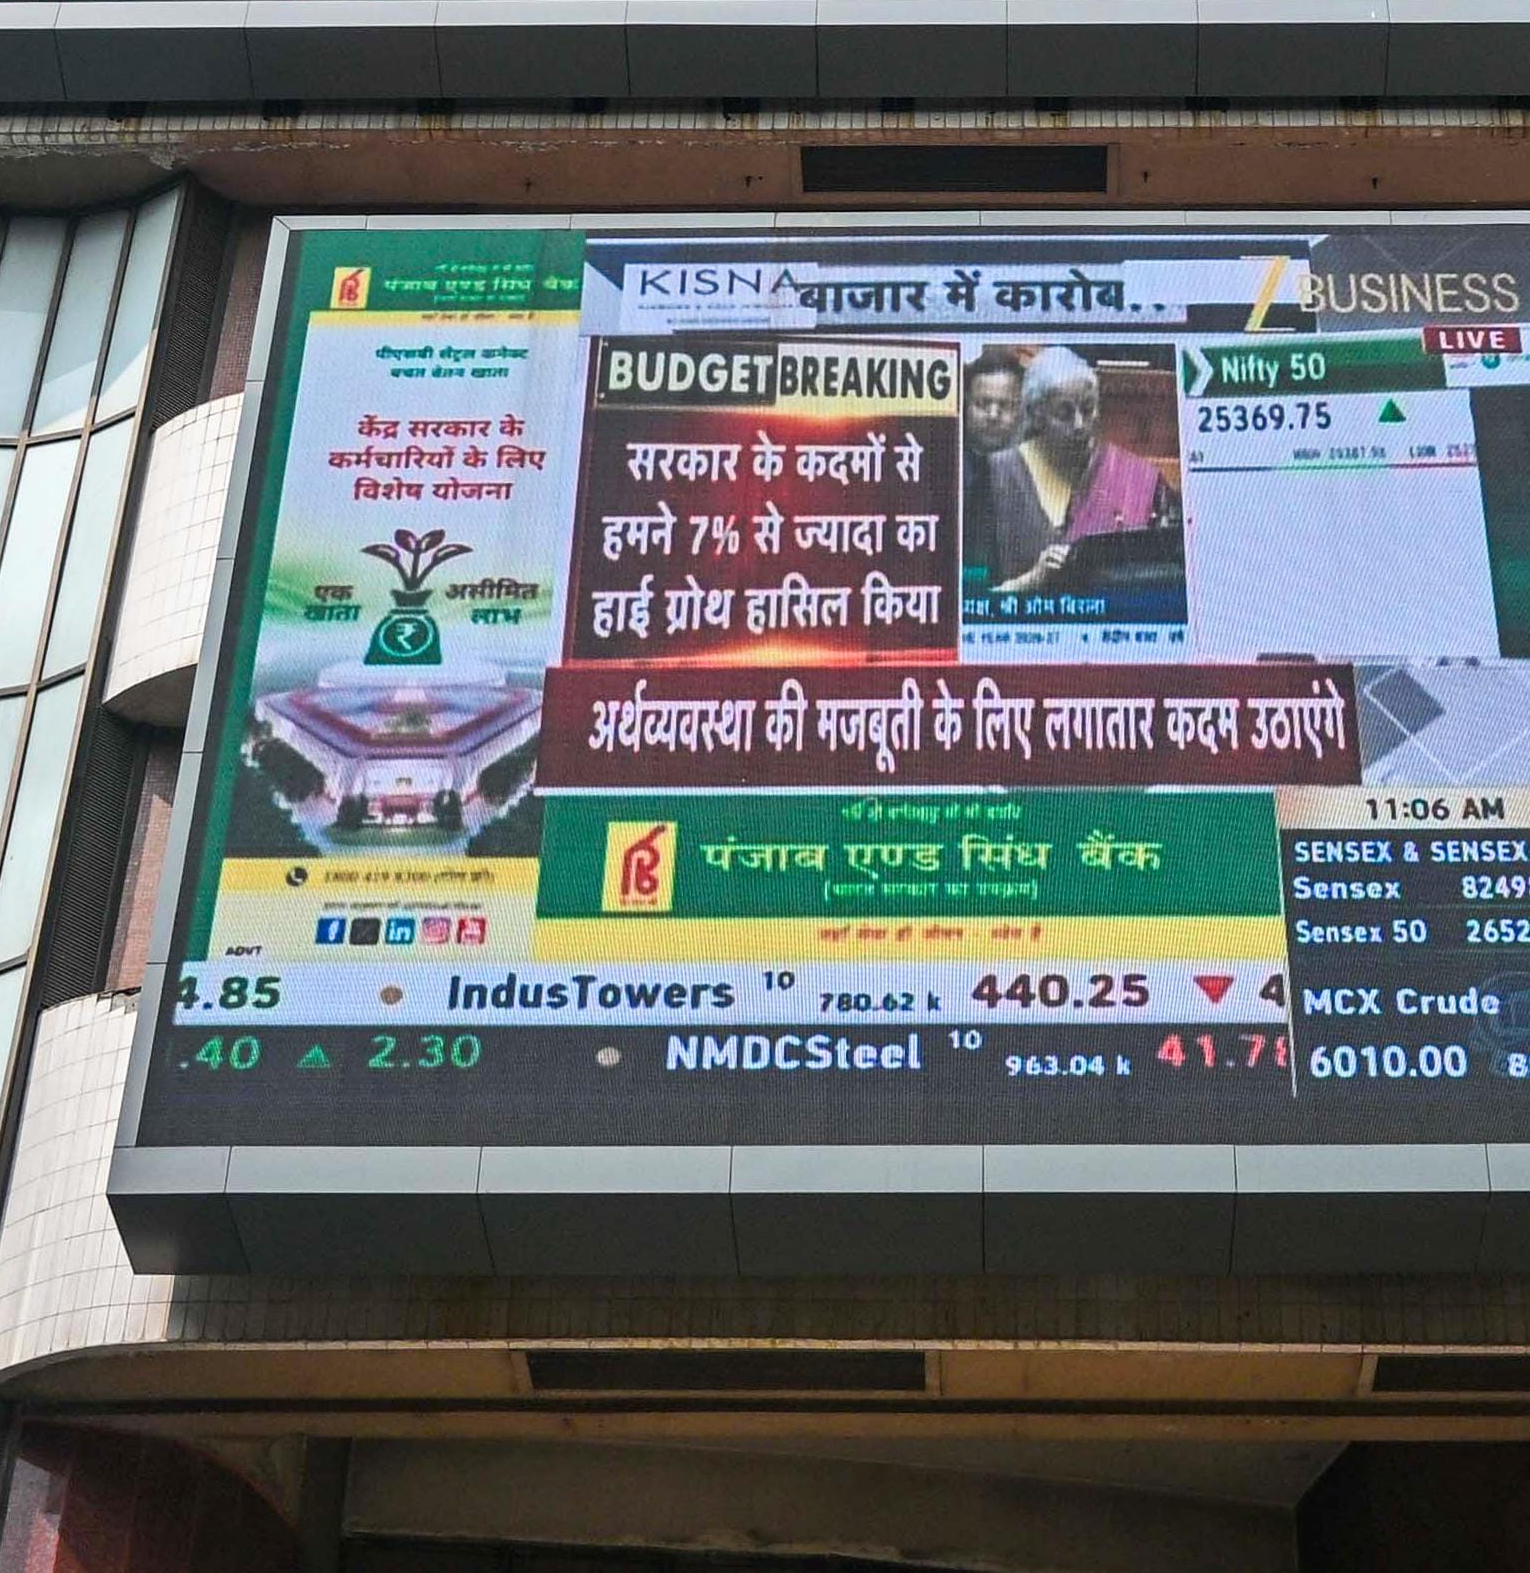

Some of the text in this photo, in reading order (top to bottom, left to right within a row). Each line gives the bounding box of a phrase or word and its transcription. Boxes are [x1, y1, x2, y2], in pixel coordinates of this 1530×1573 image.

[640, 268, 799, 296] KISNA
[797, 283, 929, 313] बाजार
[943, 269, 982, 313] में
[1299, 272, 1520, 314] BUSINESS
[1438, 330, 1506, 350] LIVE
[608, 350, 952, 400] BUDGET BREAKING
[1221, 352, 1326, 389] Nifty 50
[408, 419, 492, 438] सरकार
[499, 414, 525, 438] के
[1197, 401, 1333, 433] 25369.75
[328, 444, 547, 470] कर्मचारियों के लिए
[626, 429, 925, 486] सरकार के कदमों से
[353, 477, 514, 501] विशेष योजना
[601, 500, 940, 560] हमने 7% से ज्यादा का
[313, 583, 354, 603] एक
[591, 570, 942, 639] हाई ग्रोथ हासिल किया
[588, 676, 1346, 775] अर्थव्यवस्था की मजबूती के लिए लगातार कदम उठाएंगे
[1366, 798, 1506, 821] 11:06 AM
[700, 828, 1163, 880] पंजाब एण्ड सिंध बैंक
[1294, 841, 1393, 864] SENSEX
[1402, 841, 1420, 863] &
[1430, 840, 1528, 863] SENSEX
[1293, 875, 1402, 900] Sensex
[1295, 919, 1384, 944] Sensex
[1392, 919, 1428, 943] 50
[447, 974, 737, 1011] IndusTowers
[763, 970, 795, 991] 10
[819, 992, 914, 1013] 780.62
[926, 991, 942, 1012] k
[970, 973, 1151, 1009] 440.25
[1303, 986, 1502, 1016] MCX Crude
[367, 1033, 483, 1069] 2.30
[665, 1033, 921, 1071] NMDCSteel
[949, 1029, 983, 1050] 10
[1005, 1054, 1105, 1077] 963.04
[1115, 1055, 1131, 1076] k
[1310, 1044, 1469, 1079] 6010.00
